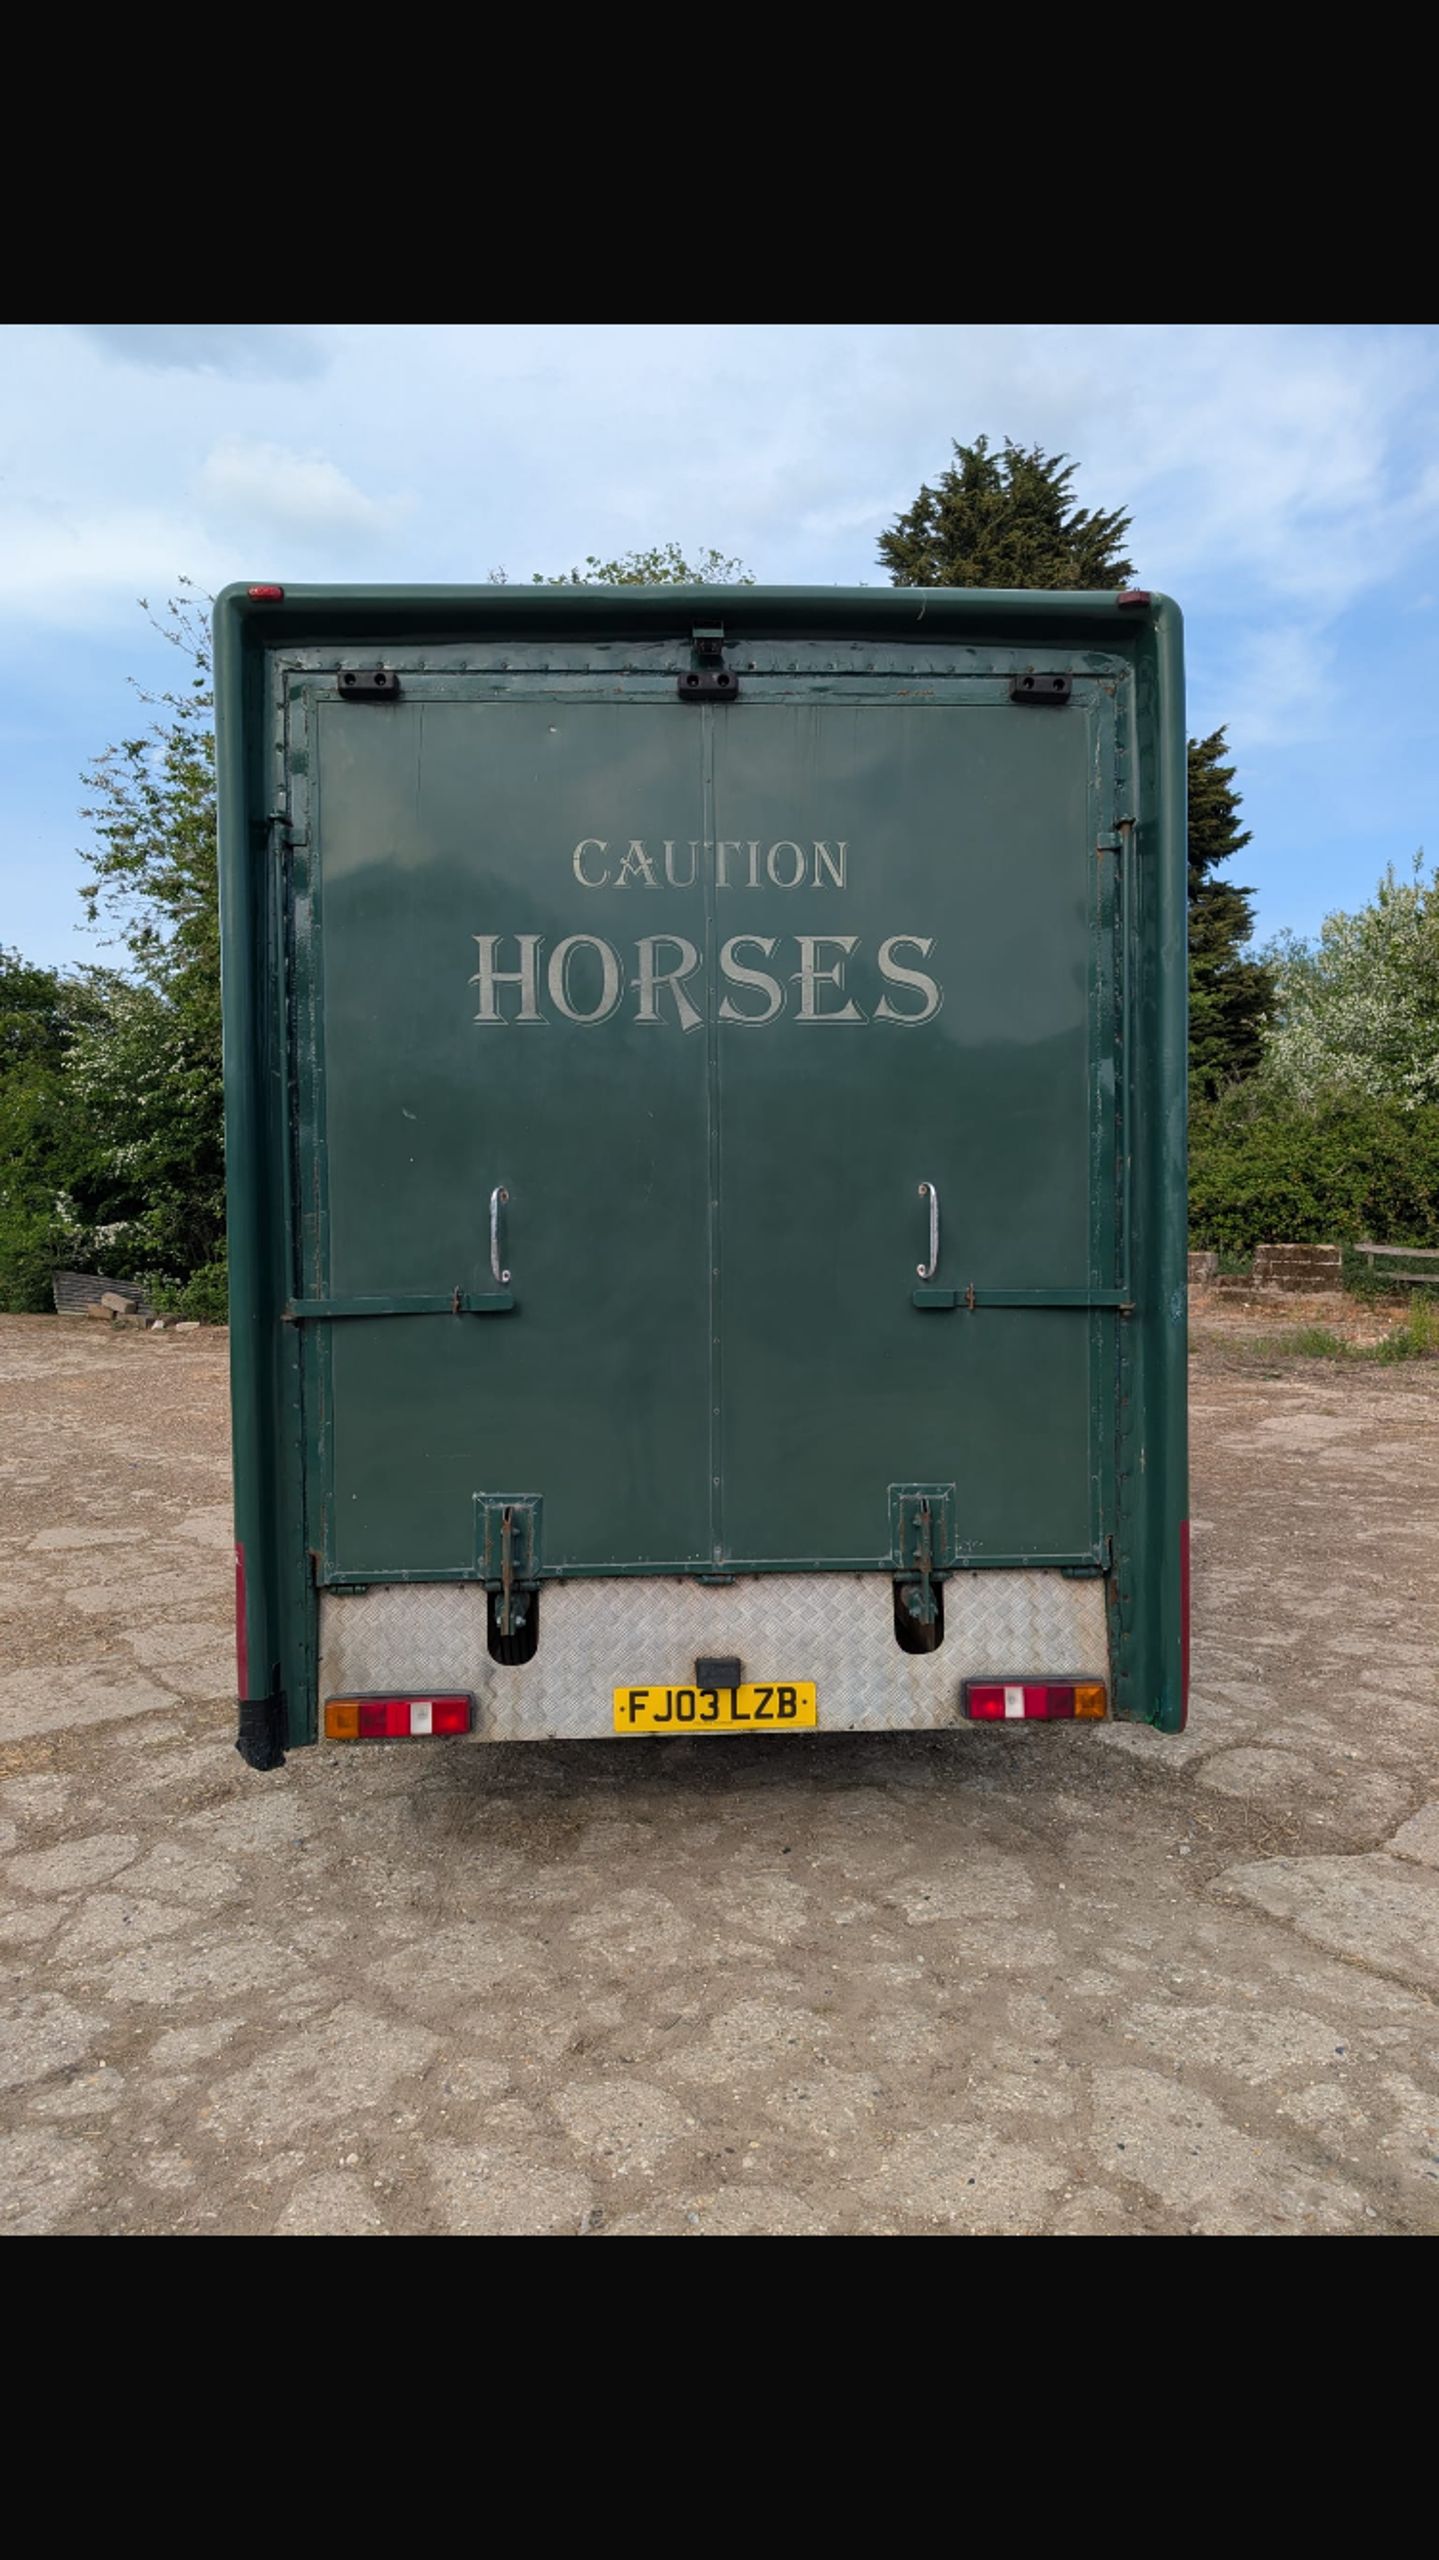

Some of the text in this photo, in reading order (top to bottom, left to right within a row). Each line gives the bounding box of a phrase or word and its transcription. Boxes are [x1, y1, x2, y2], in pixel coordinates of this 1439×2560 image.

[572, 838, 848, 888] CAUTION
[467, 934, 944, 1032] HORSES
[628, 1687, 797, 1723] FJ03 LZB
